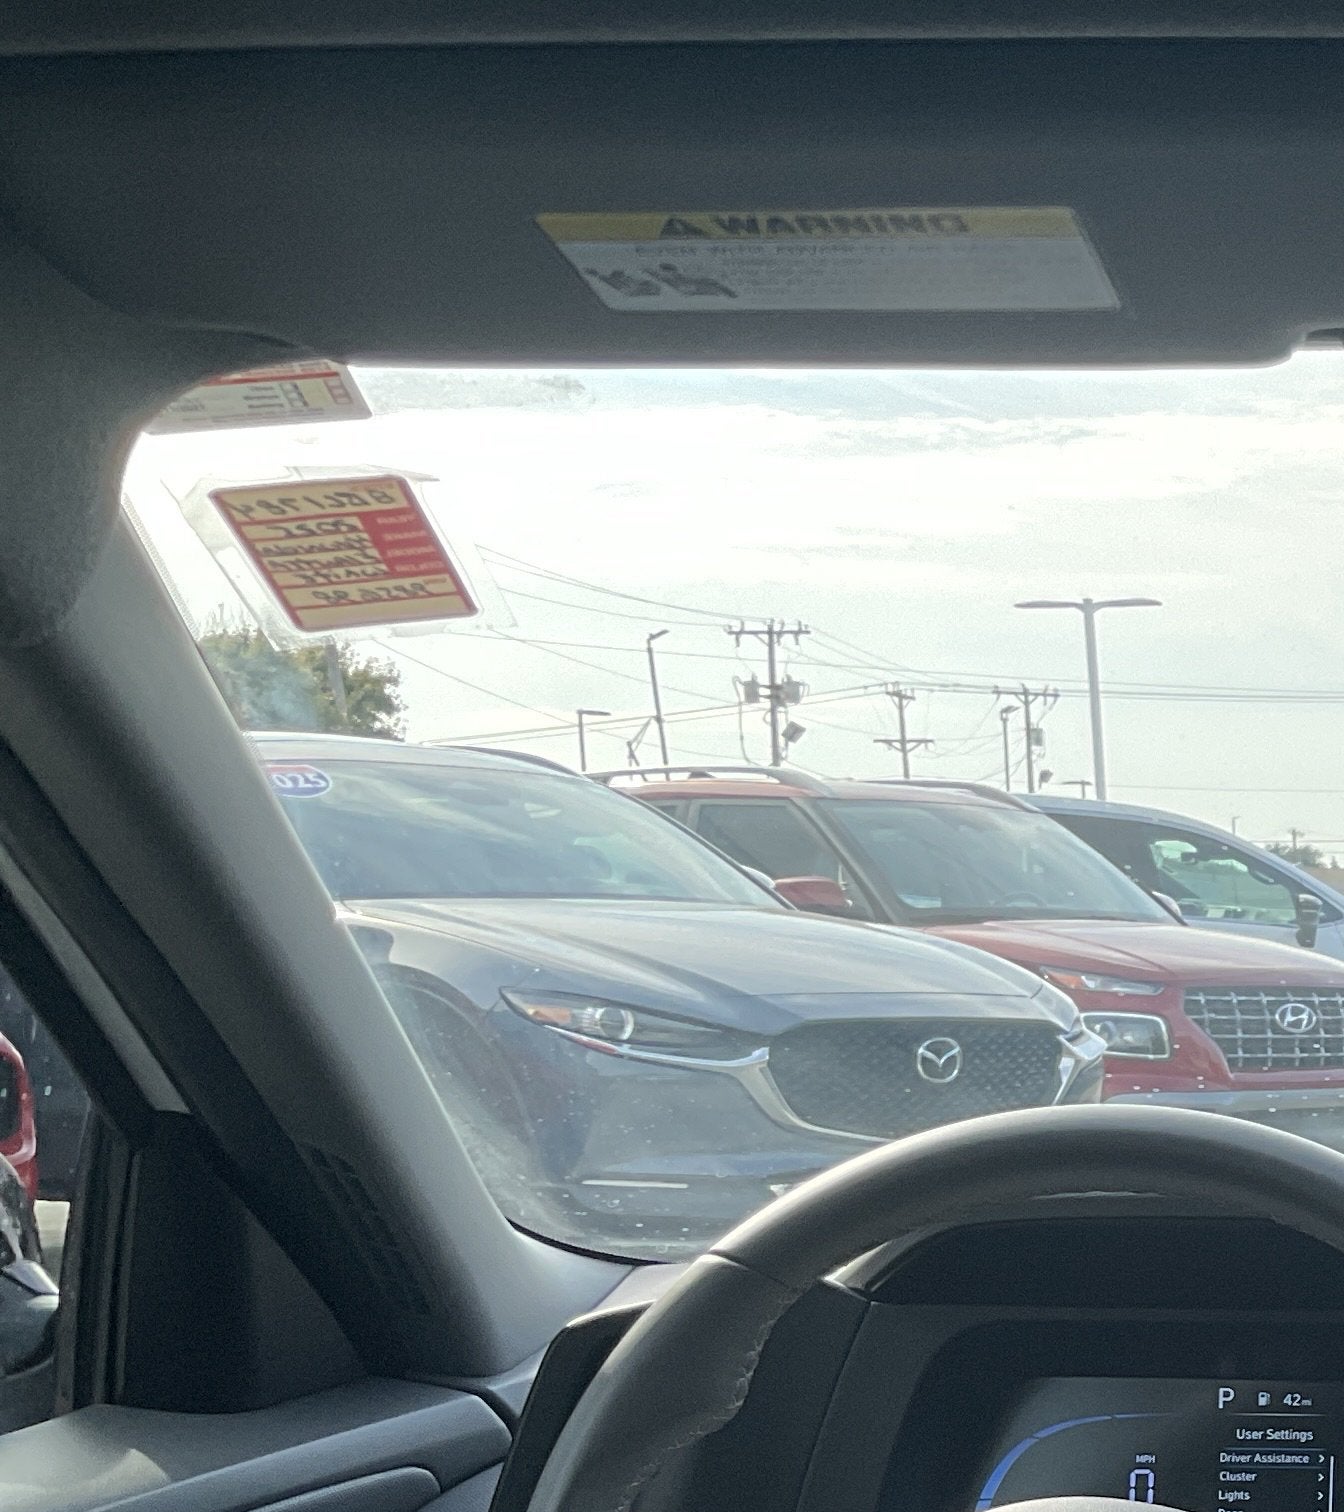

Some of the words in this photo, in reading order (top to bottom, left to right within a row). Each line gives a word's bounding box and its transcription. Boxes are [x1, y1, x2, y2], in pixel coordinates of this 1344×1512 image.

[707, 212, 970, 236] WARNING
[1218, 1386, 1235, 1409] P
[1236, 1428, 1264, 1440] User
[1266, 1427, 1314, 1443] Settings
[1136, 1454, 1156, 1464] MPH
[1219, 1452, 1252, 1463] Driver
[1253, 1452, 1310, 1464] Assistance
[1219, 1471, 1257, 1482] Cluster
[1218, 1489, 1251, 1503] Lights
